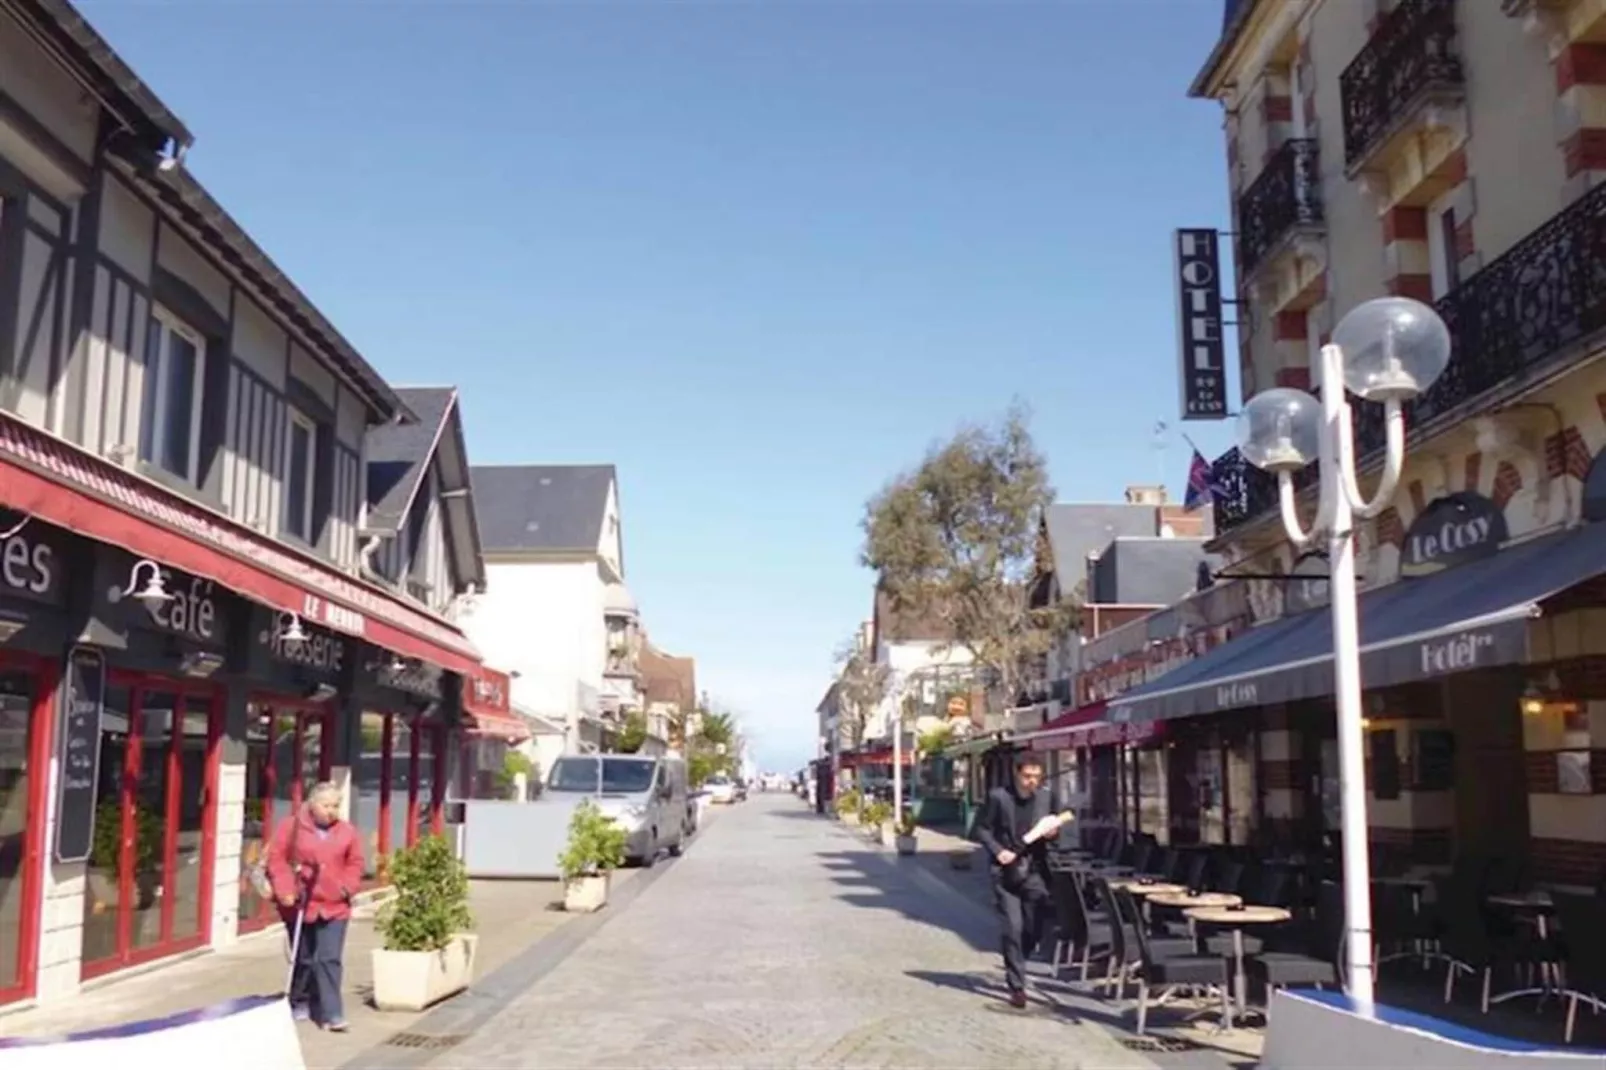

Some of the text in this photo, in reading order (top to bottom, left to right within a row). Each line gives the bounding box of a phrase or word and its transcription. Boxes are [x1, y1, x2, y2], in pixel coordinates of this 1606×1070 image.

[1181, 232, 1221, 370] HOTEL
[0, 534, 52, 594] es
[1412, 513, 1491, 564] Le Cosy
[303, 593, 320, 619] LE
